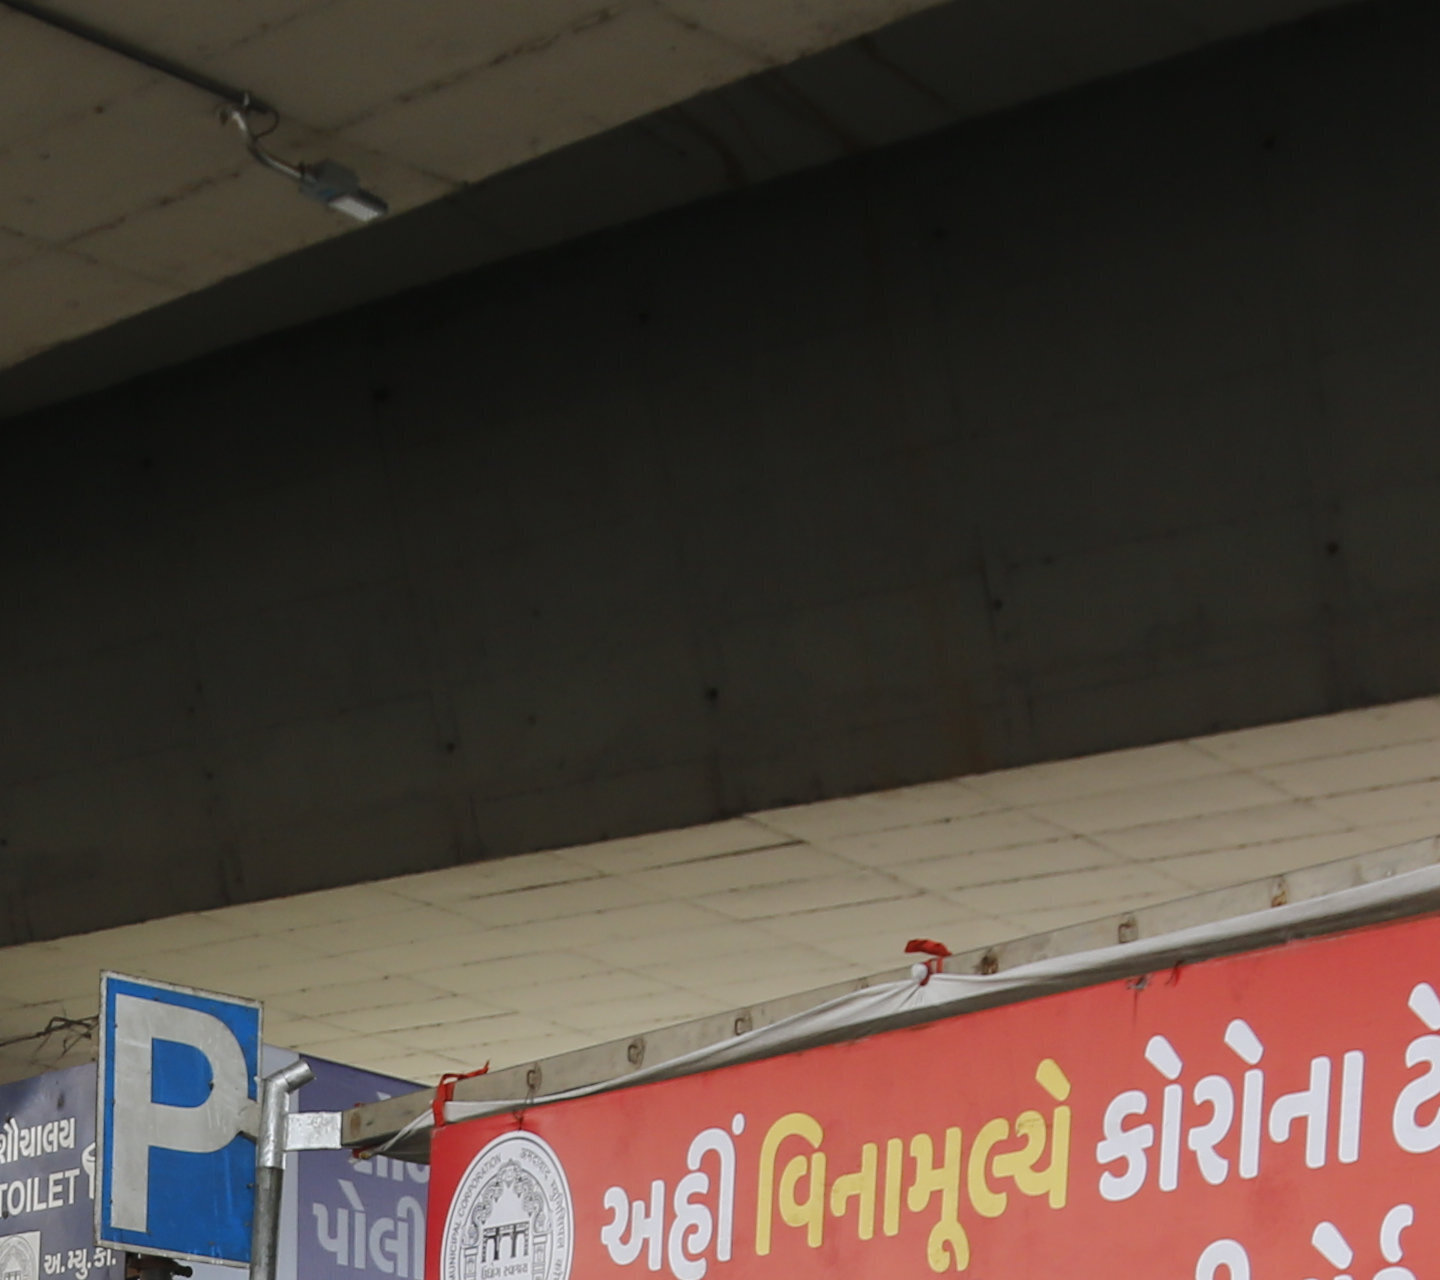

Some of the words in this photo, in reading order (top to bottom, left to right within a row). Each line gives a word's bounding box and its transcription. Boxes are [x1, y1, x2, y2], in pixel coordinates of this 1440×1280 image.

[110, 993, 249, 1233] P
[313, 1179, 424, 1280] પોલી
[755, 1058, 1071, 1272] વિનામૂલ્યે
[1096, 1018, 1364, 1201] કોરોના
